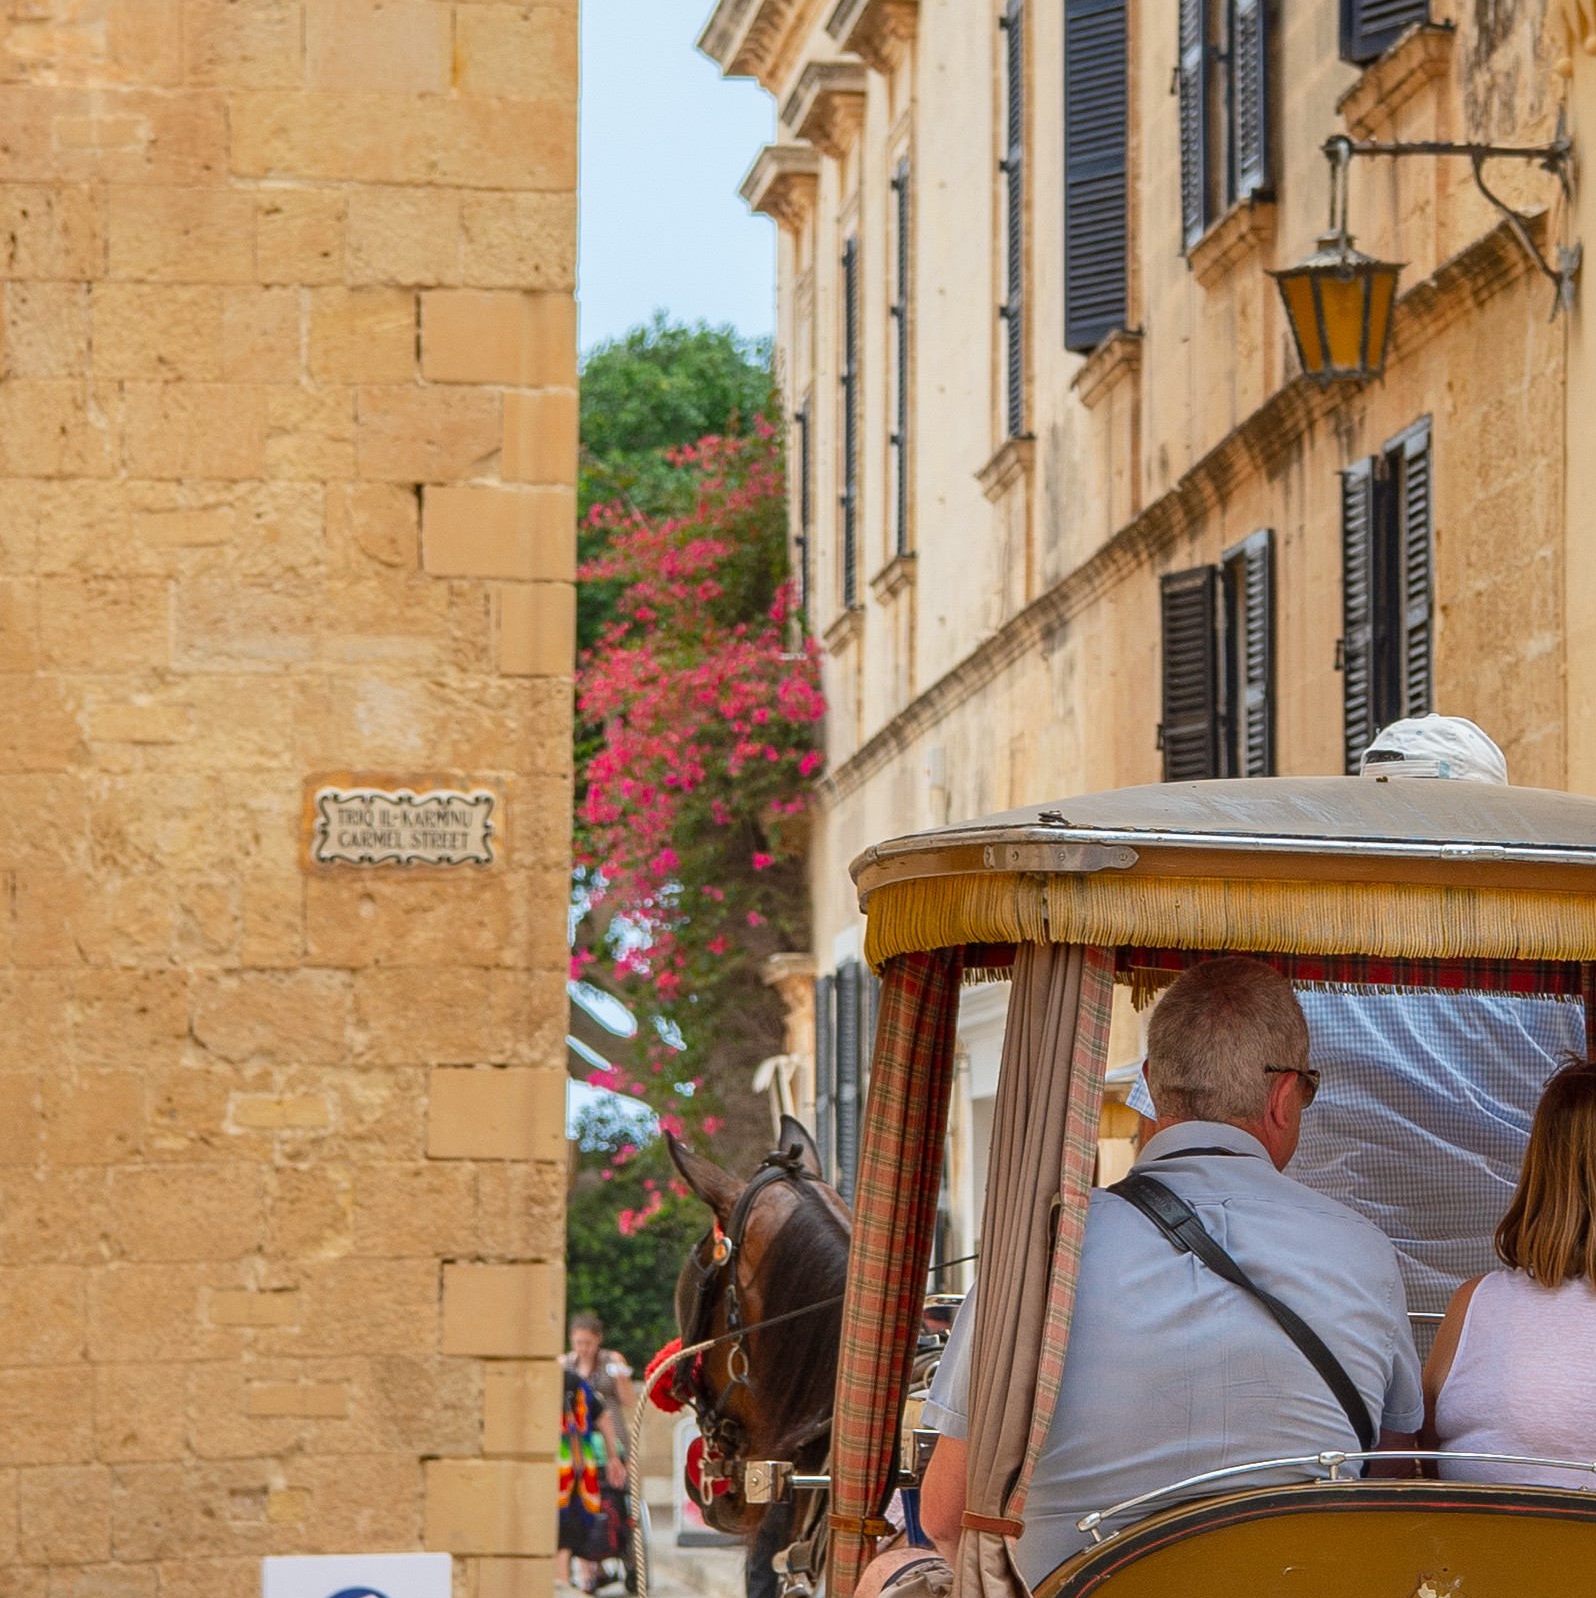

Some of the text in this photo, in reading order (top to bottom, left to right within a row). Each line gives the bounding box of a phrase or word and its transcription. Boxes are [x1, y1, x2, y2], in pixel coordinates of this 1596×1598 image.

[337, 808, 474, 829] TRIQ IL-KARMNU
[337, 830, 469, 850] CARMEL STREET
